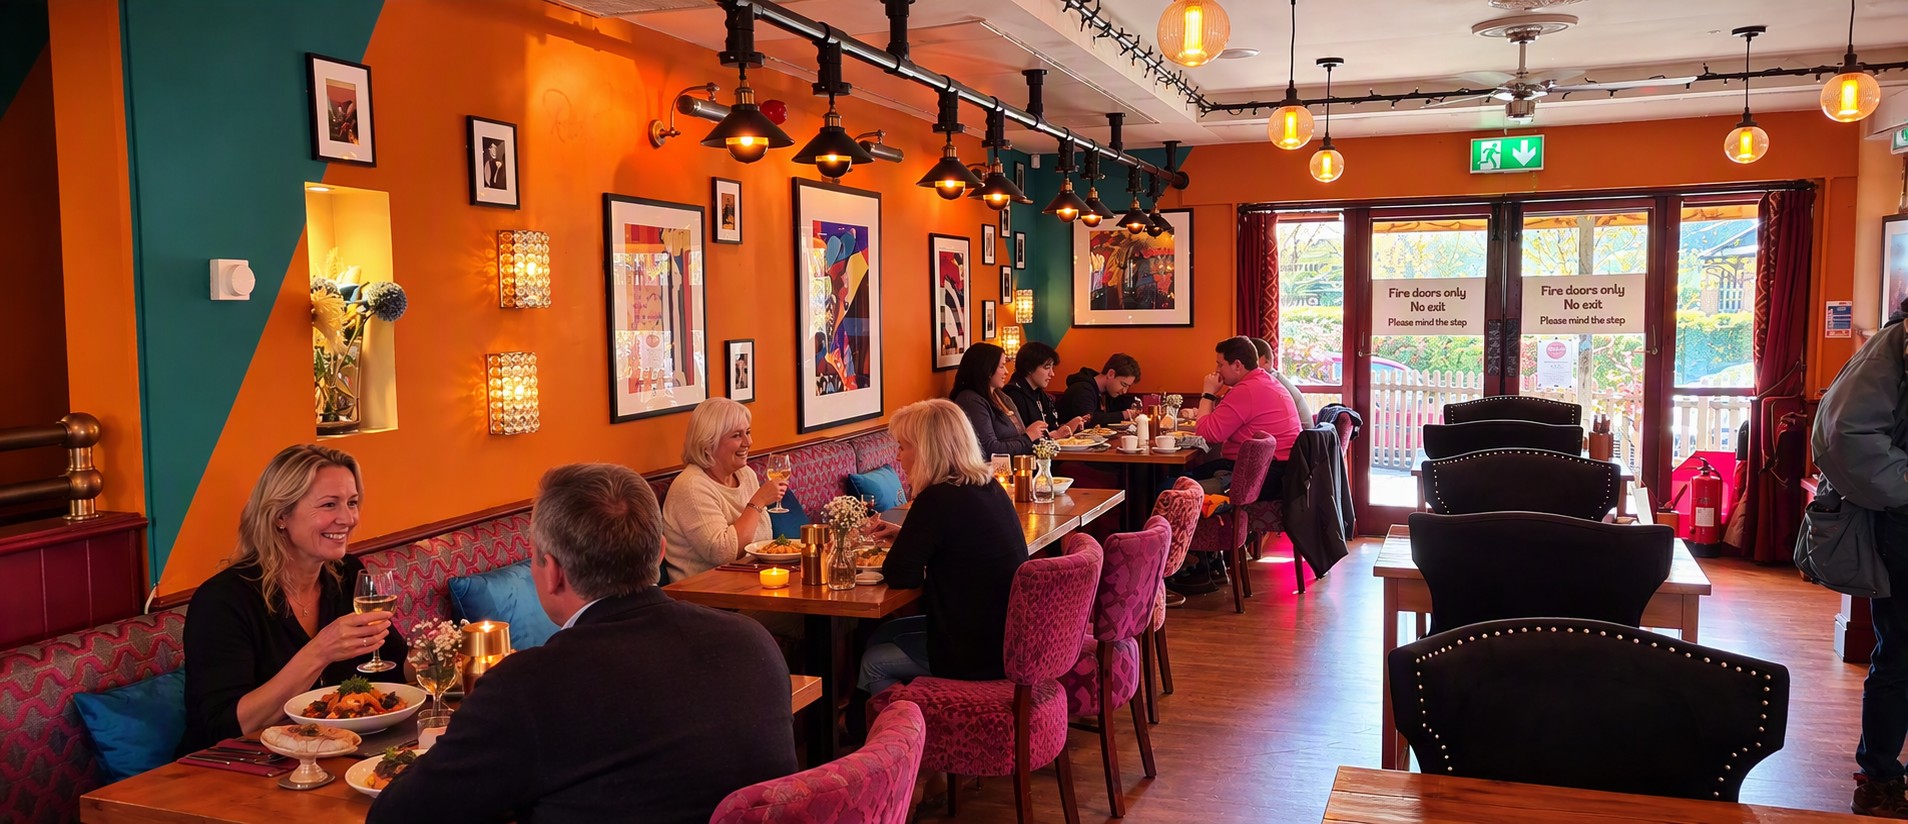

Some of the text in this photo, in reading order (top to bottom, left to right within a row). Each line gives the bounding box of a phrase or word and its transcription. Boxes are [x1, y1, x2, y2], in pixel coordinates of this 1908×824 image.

[1389, 287, 1466, 300] Fire doors only
[1541, 284, 1625, 297] Fire doors only
[1410, 302, 1446, 312] No exit
[1564, 299, 1603, 310] No exit
[1388, 318, 1467, 328] Please mind the step
[1540, 315, 1626, 326] Please mind the step
